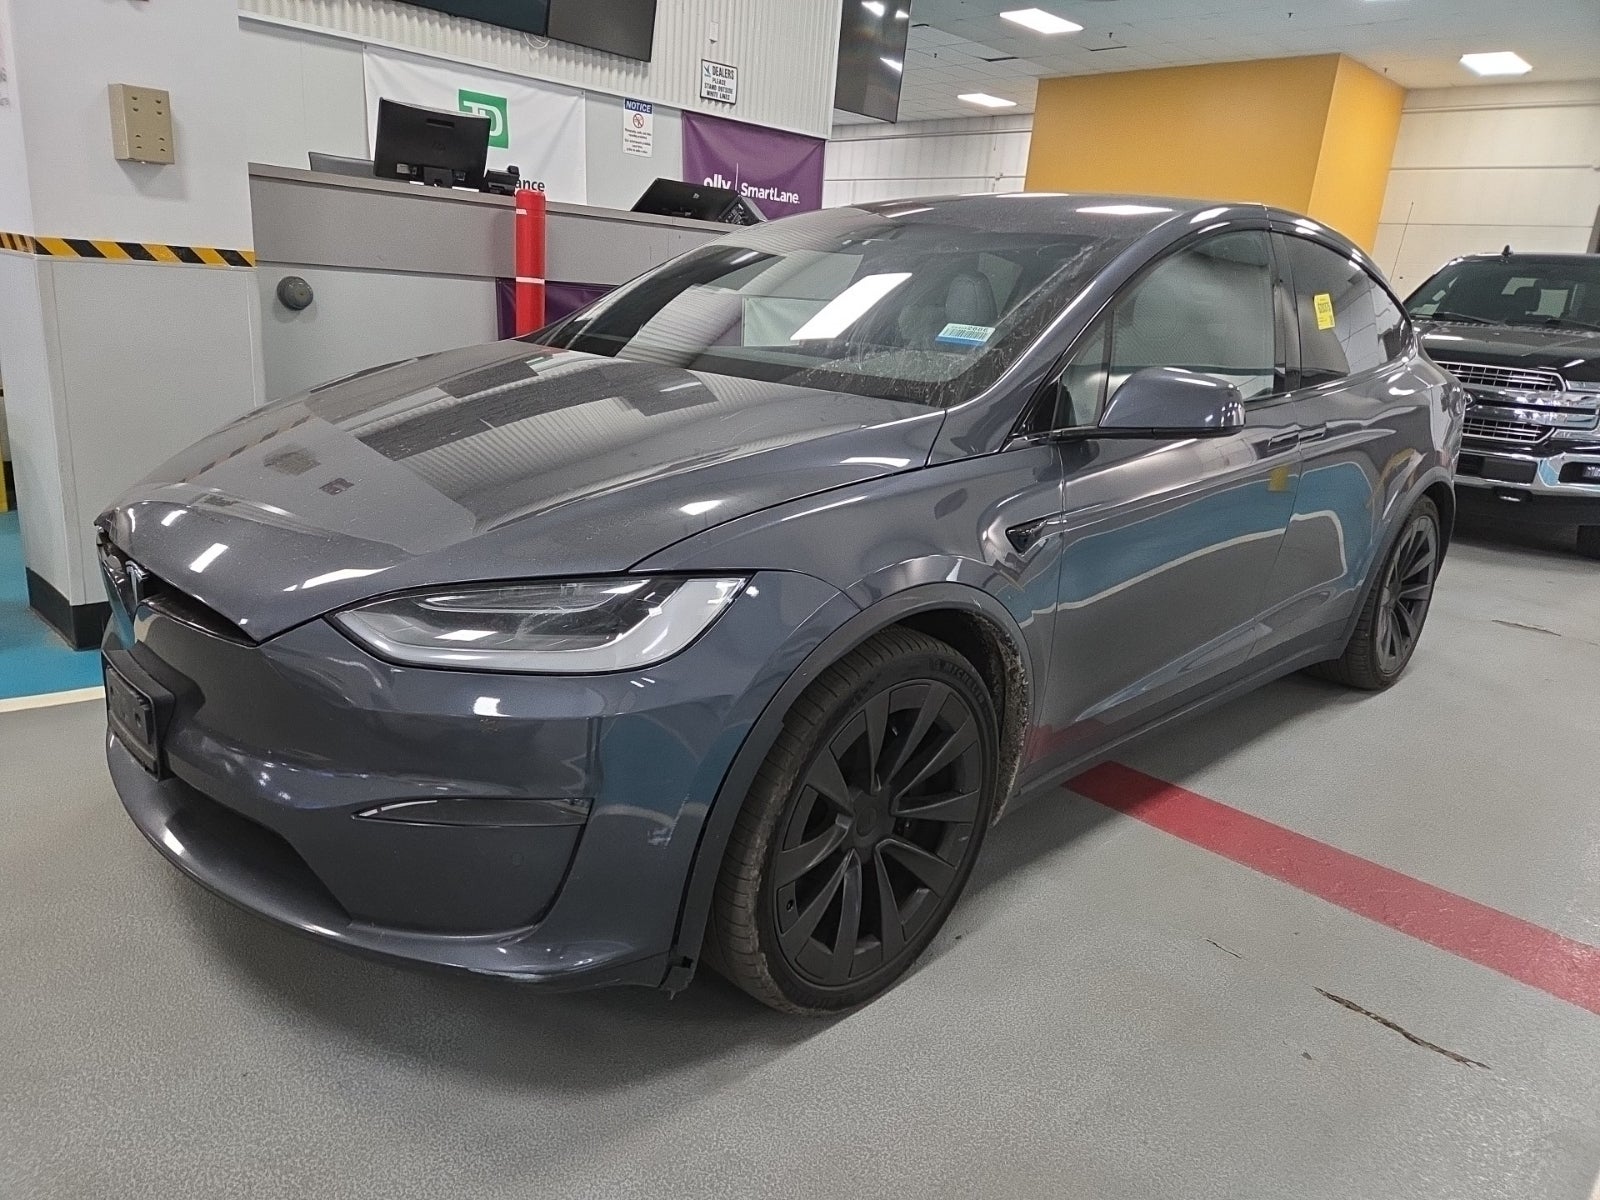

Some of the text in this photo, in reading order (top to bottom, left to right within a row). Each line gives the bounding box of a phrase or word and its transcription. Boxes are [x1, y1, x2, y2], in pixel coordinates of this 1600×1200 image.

[712, 65, 734, 80] DEALERS
[625, 100, 651, 113] NOTICE
[515, 180, 545, 192] ance
[943, 661, 985, 704] MICHELIN
